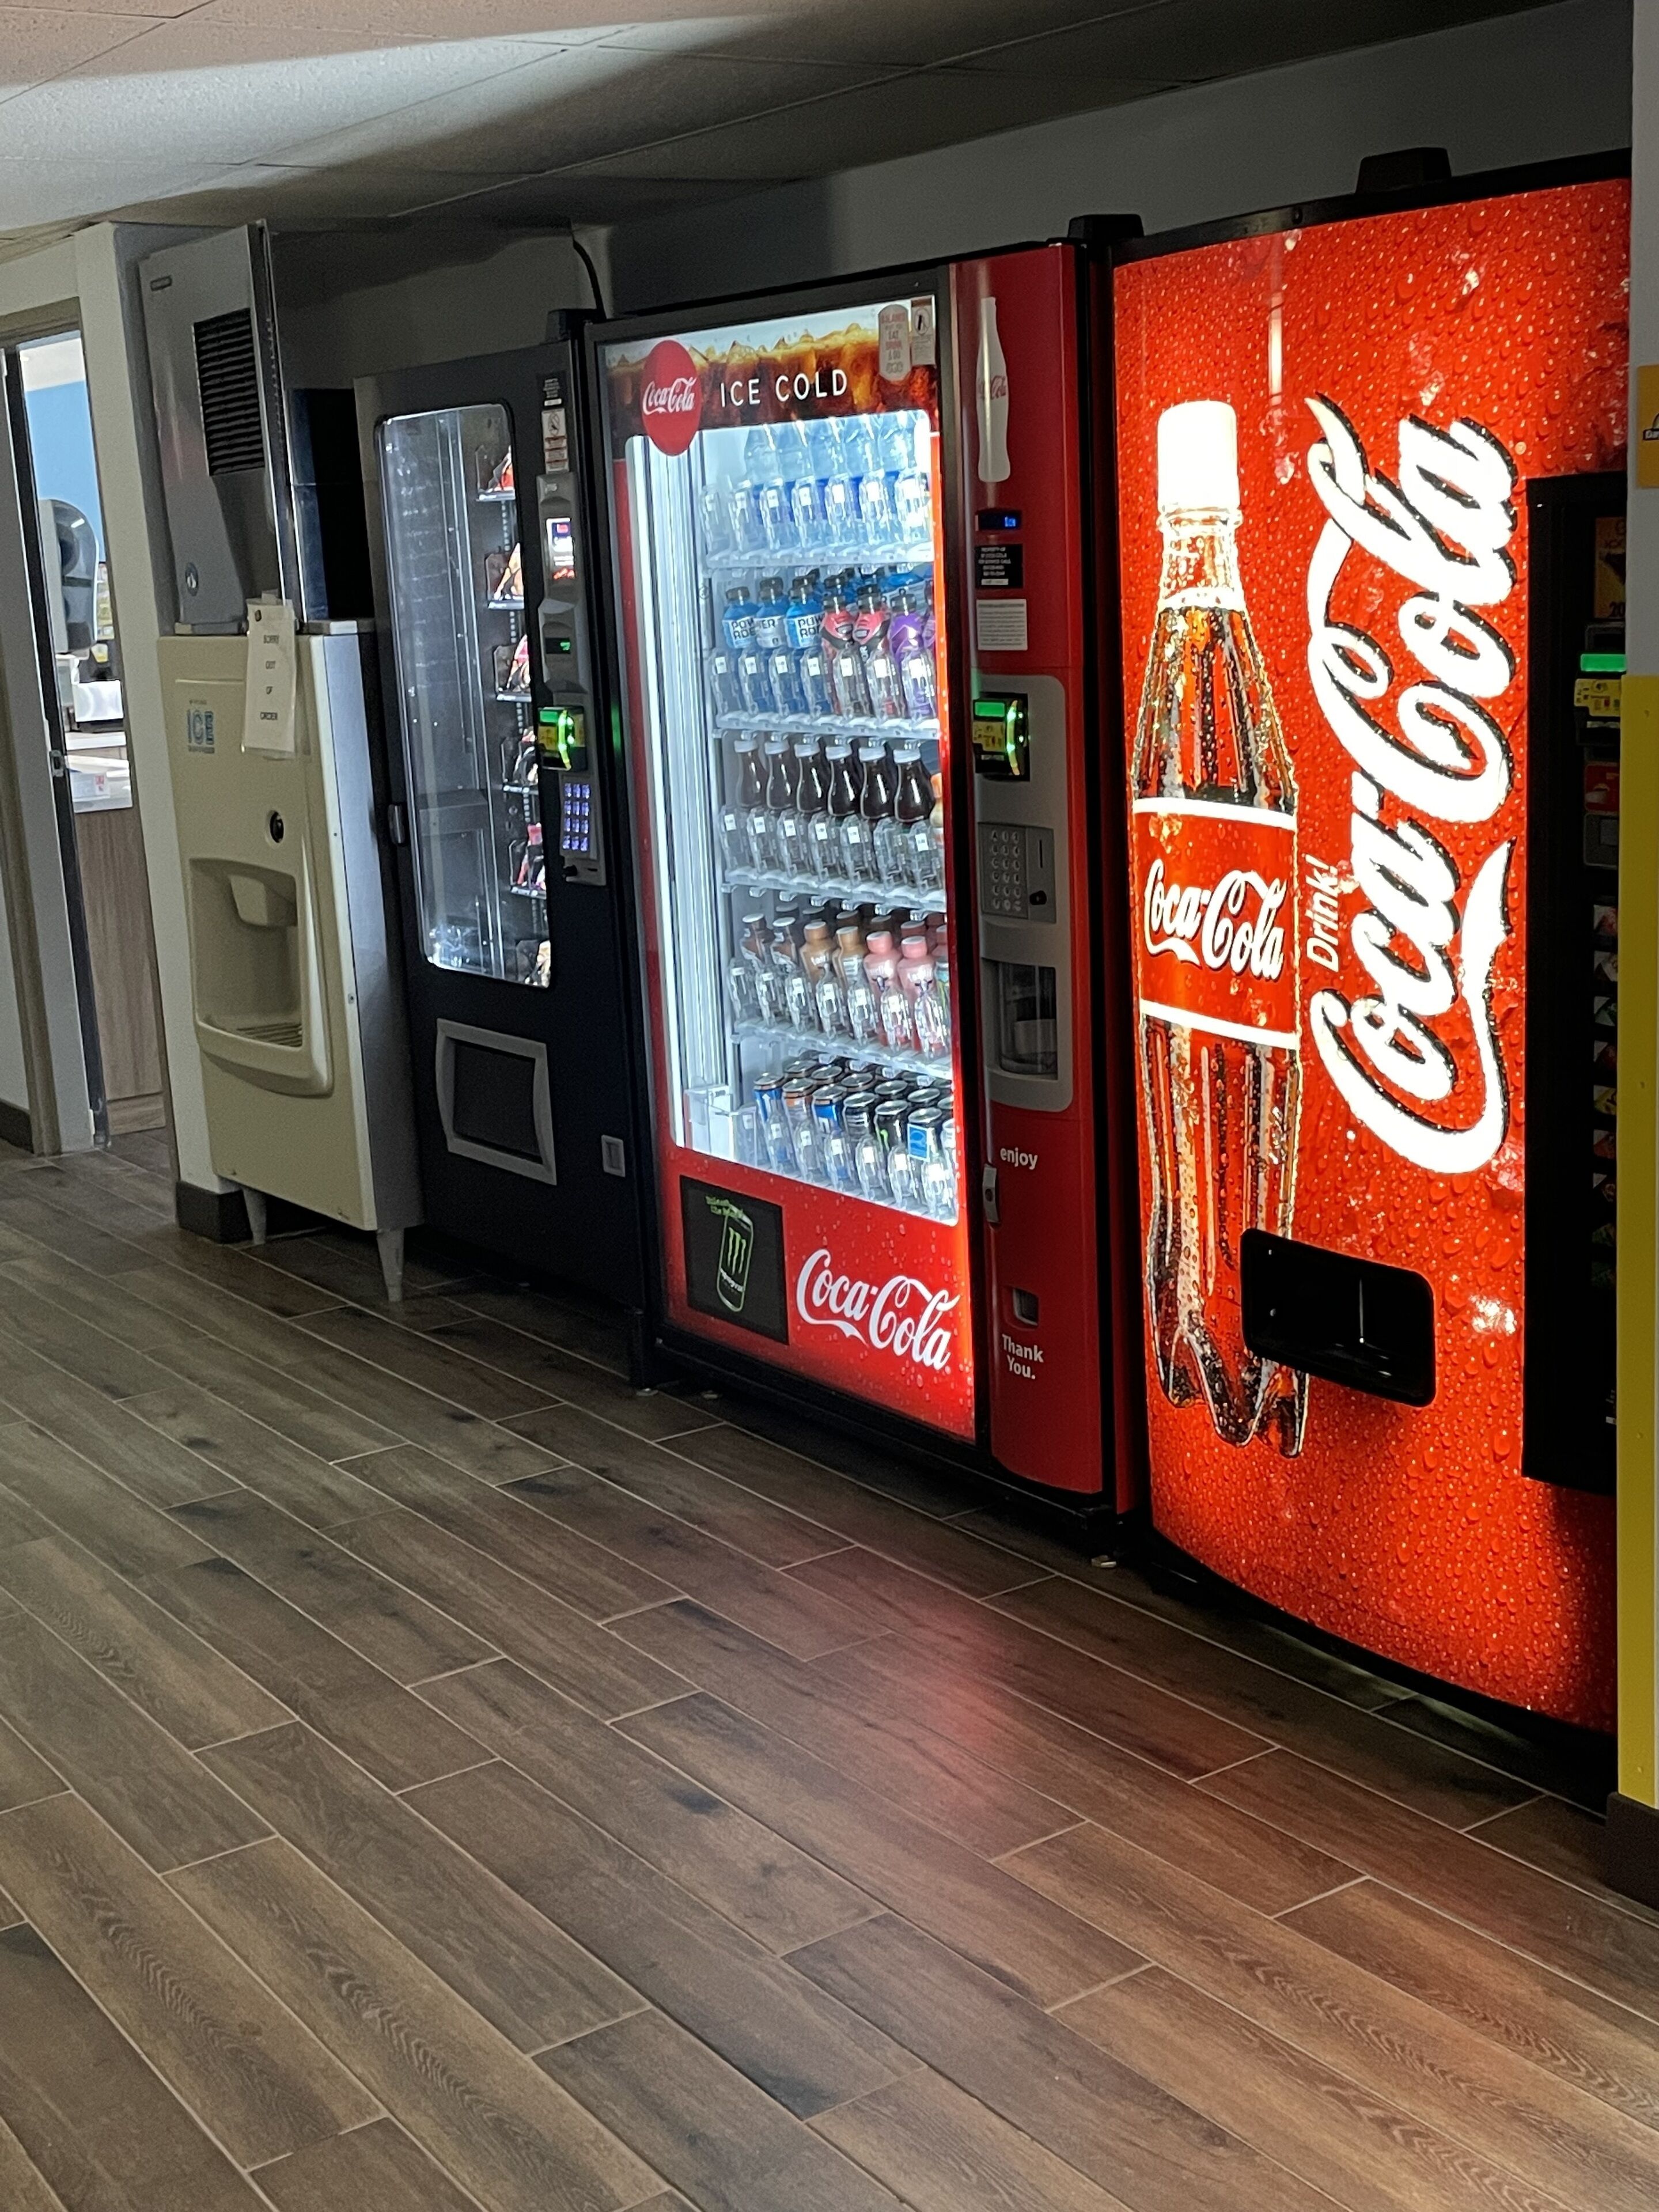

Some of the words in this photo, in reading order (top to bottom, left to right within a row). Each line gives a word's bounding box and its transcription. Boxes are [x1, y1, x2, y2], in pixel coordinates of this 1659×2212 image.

[720, 378, 761, 407] ICE
[775, 369, 848, 402] COLD
[1304, 393, 1518, 1175] Coca-Cola
[1143, 858, 1288, 982] Coca-Cola
[1304, 853, 1340, 973] Drink!
[1000, 1147, 1038, 1170] enjoy
[797, 1248, 961, 1370] Coca-Cola
[1002, 1334, 1044, 1363] Thank
[1007, 1355, 1036, 1380] You.
